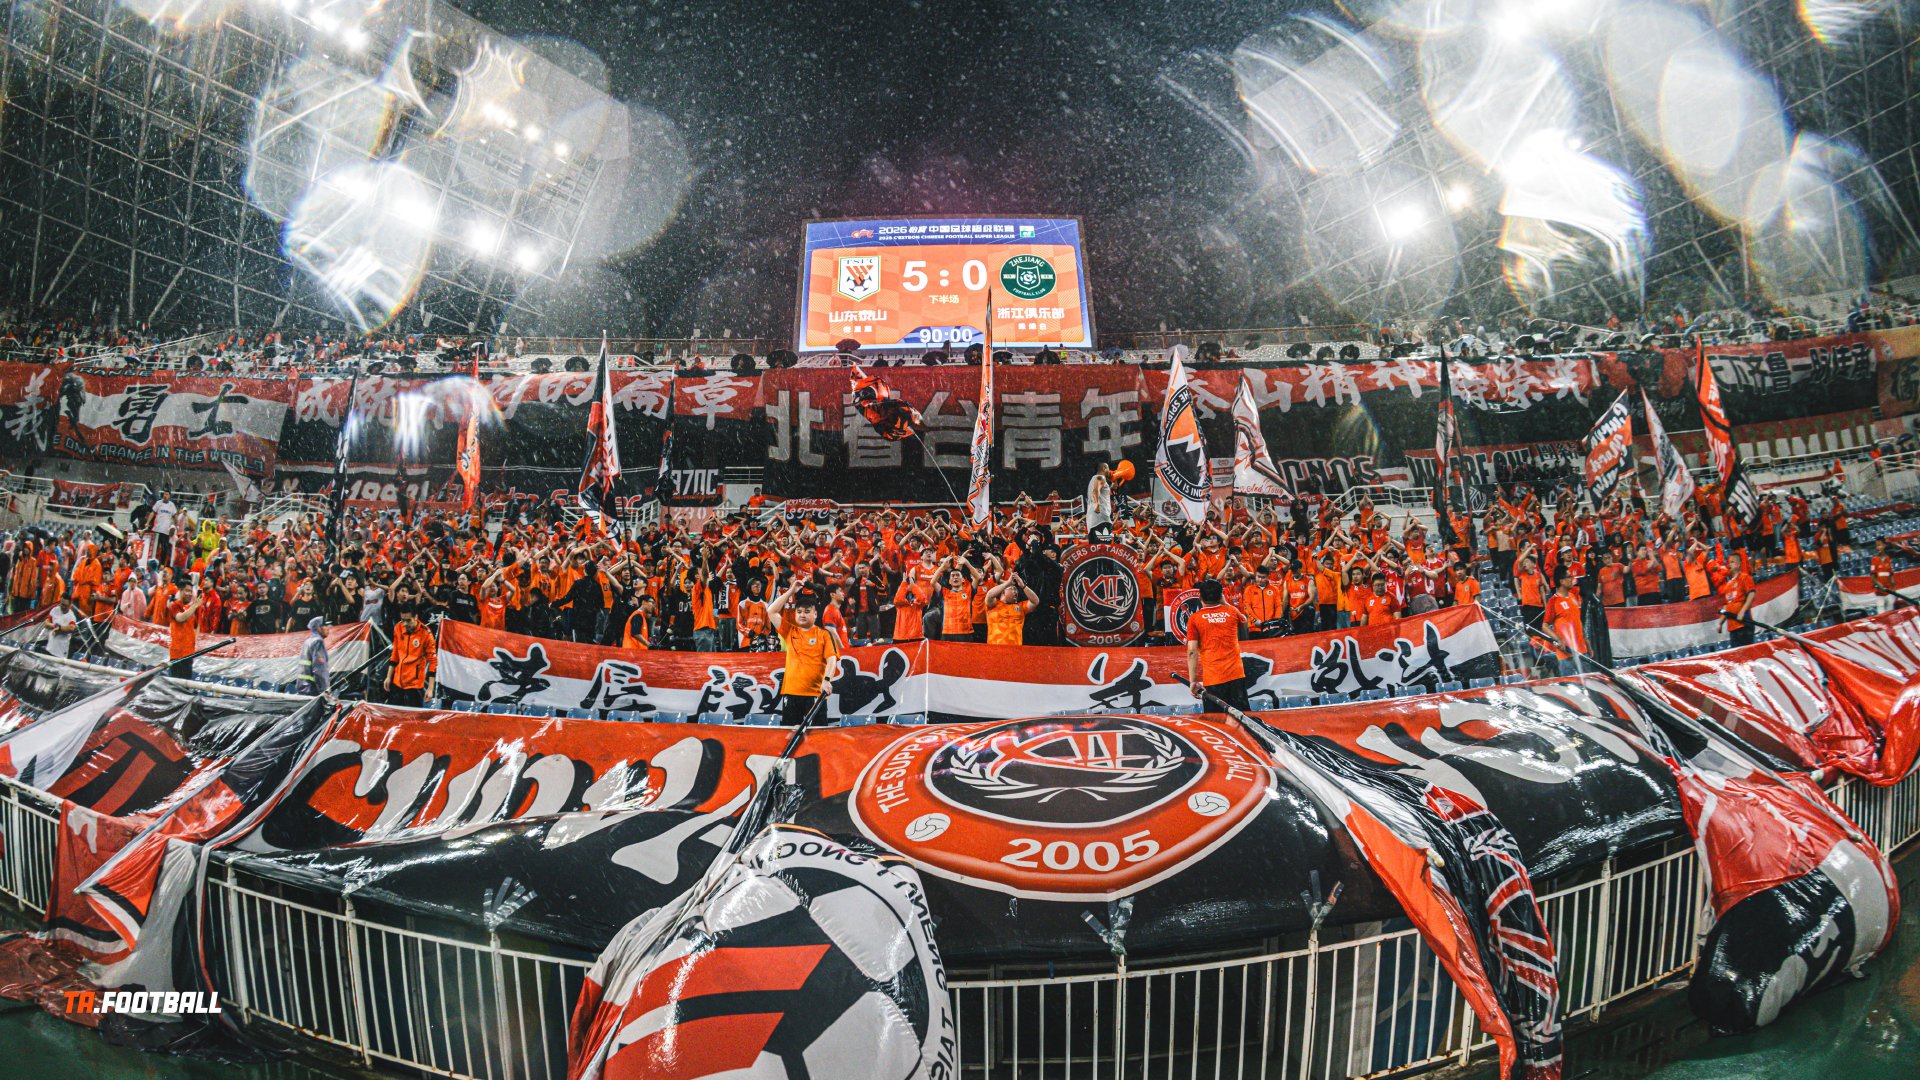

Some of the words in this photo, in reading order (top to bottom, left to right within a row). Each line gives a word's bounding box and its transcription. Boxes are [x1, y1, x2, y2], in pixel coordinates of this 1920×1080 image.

[879, 226, 907, 234] 2026
[1008, 256, 1046, 268] ZHEJIANG
[928, 295, 960, 305] 下半场
[828, 309, 888, 323] 山东泰山
[996, 307, 1065, 319] 浙江俱乐部
[919, 327, 973, 343] 90:00
[156, 446, 169, 459] IN
[1104, 544, 1141, 568] TAISHAN
[1087, 633, 1123, 645] 2005
[876, 779, 910, 815] THE
[1000, 829, 1161, 872] 2005
